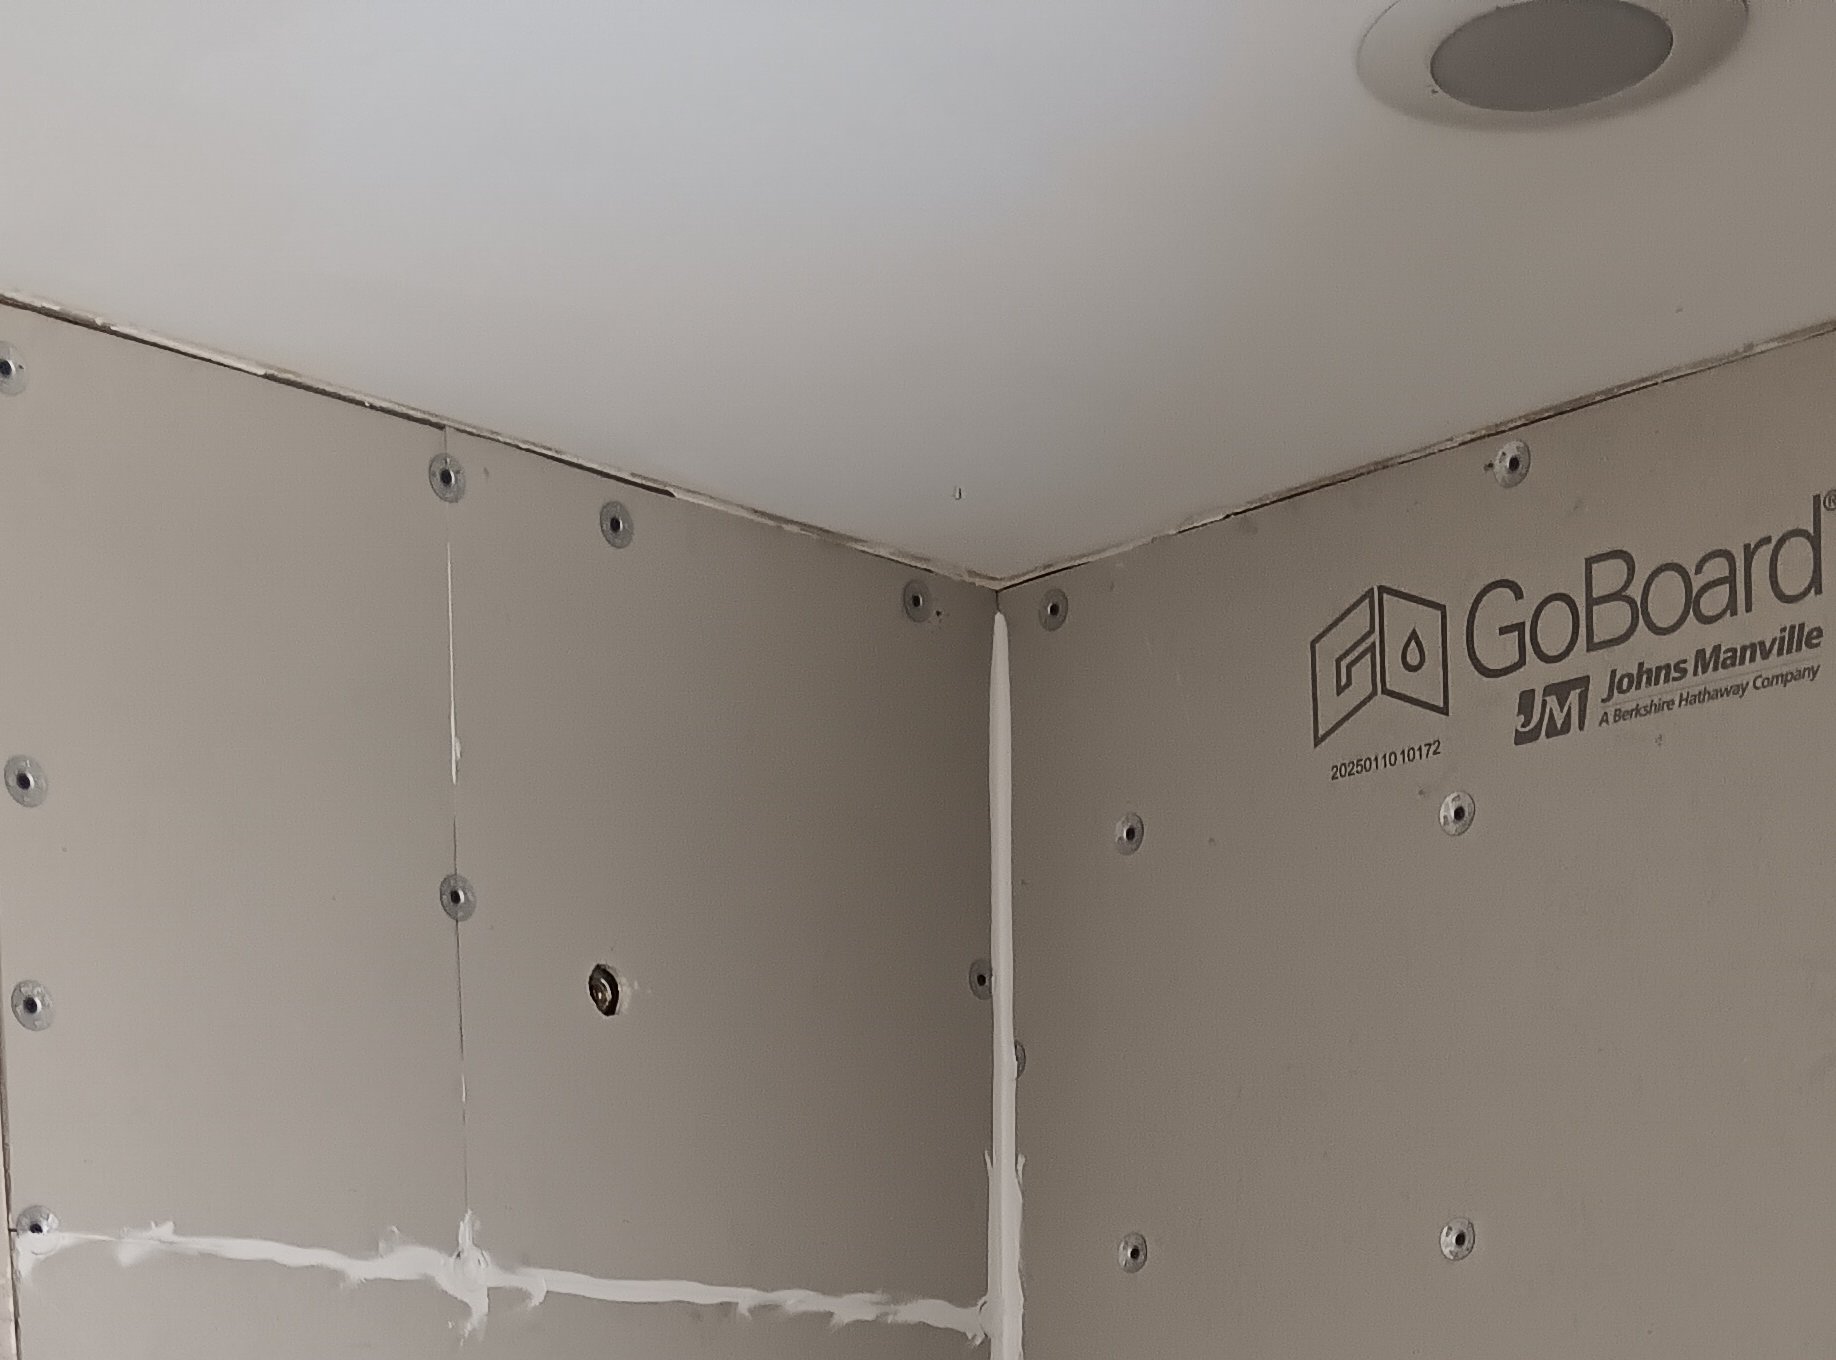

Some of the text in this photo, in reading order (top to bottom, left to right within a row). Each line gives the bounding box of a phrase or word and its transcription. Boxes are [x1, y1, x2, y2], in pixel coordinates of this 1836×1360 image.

[1599, 663, 1821, 728] A Berkshire Hathaway Company
[1602, 622, 1824, 704] Johns Manville
